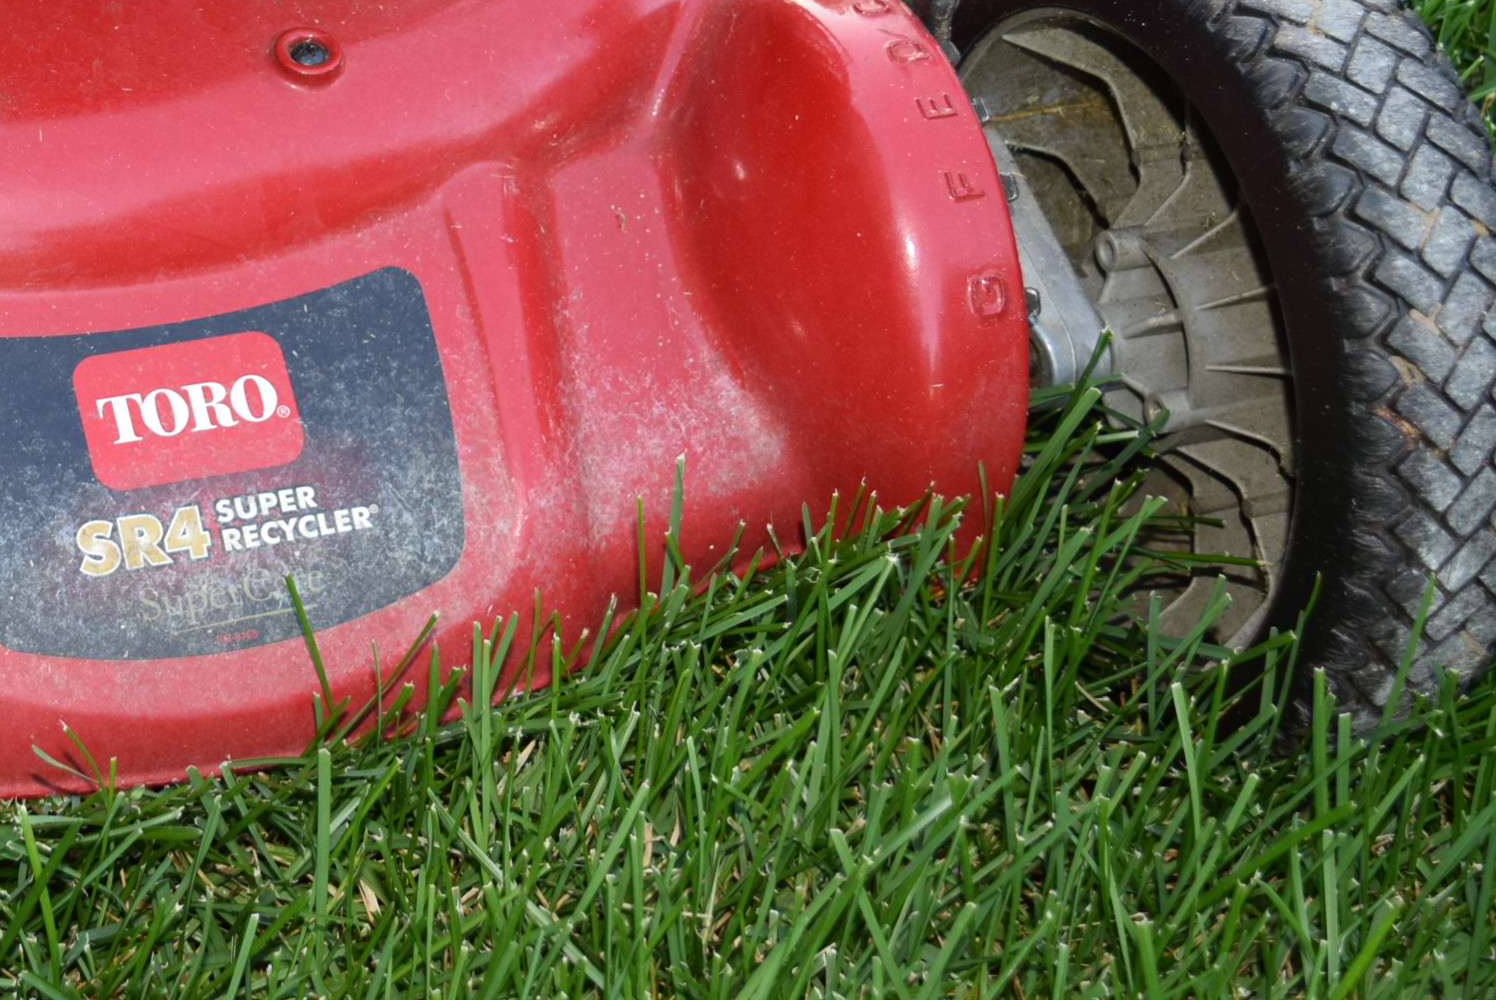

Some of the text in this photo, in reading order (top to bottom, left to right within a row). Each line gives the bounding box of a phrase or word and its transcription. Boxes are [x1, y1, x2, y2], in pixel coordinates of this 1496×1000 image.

[886, 38, 930, 65] D
[915, 91, 959, 121] E
[944, 171, 986, 203] F
[967, 273, 1006, 319] G
[76, 486, 318, 577] SR4 SUPER
